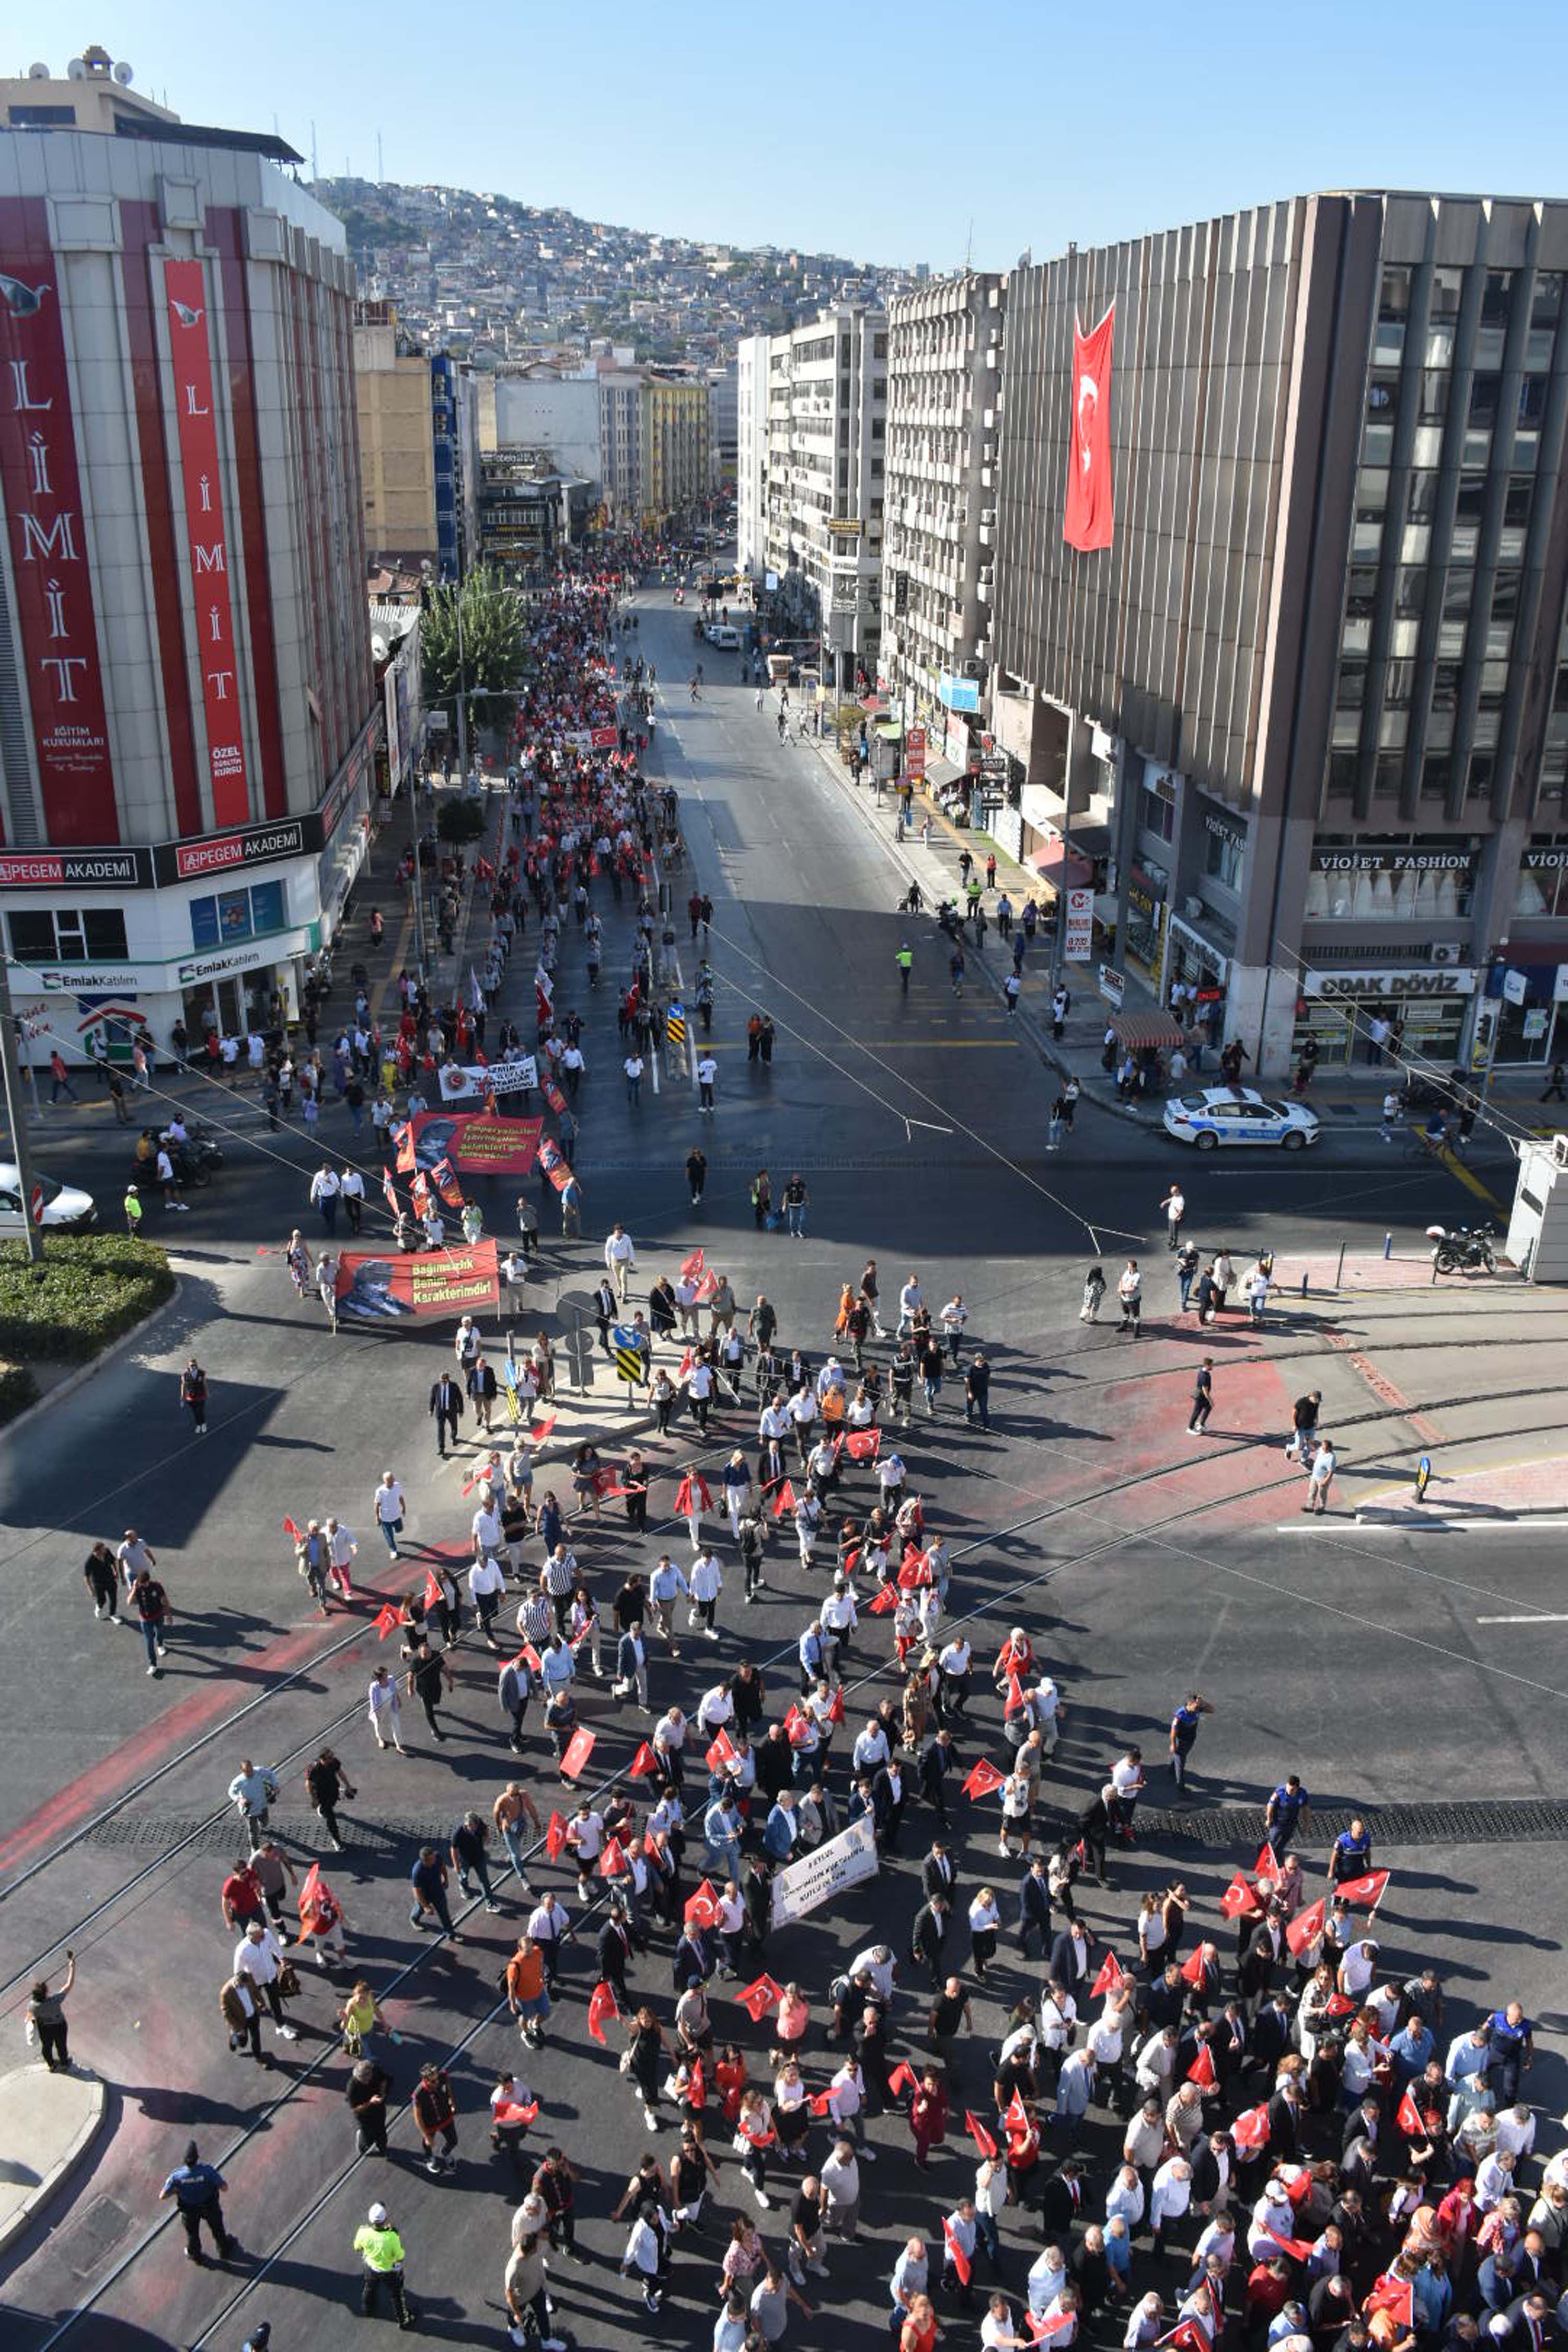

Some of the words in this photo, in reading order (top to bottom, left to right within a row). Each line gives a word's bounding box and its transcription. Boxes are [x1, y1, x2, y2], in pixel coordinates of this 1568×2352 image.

[9, 360, 87, 702] LİMİT
[185, 385, 233, 701] LİMİT
[213, 746, 240, 759] ÖZEL
[200, 843, 243, 866] PEGEM
[245, 828, 297, 856] AKADEMİ
[11, 863, 62, 879] PEGEM
[65, 859, 130, 878] AKADEMİ
[1393, 853, 1471, 869] FASHİON
[1321, 977, 1385, 994] ODAK
[1390, 973, 1460, 993] DÖVİZ
